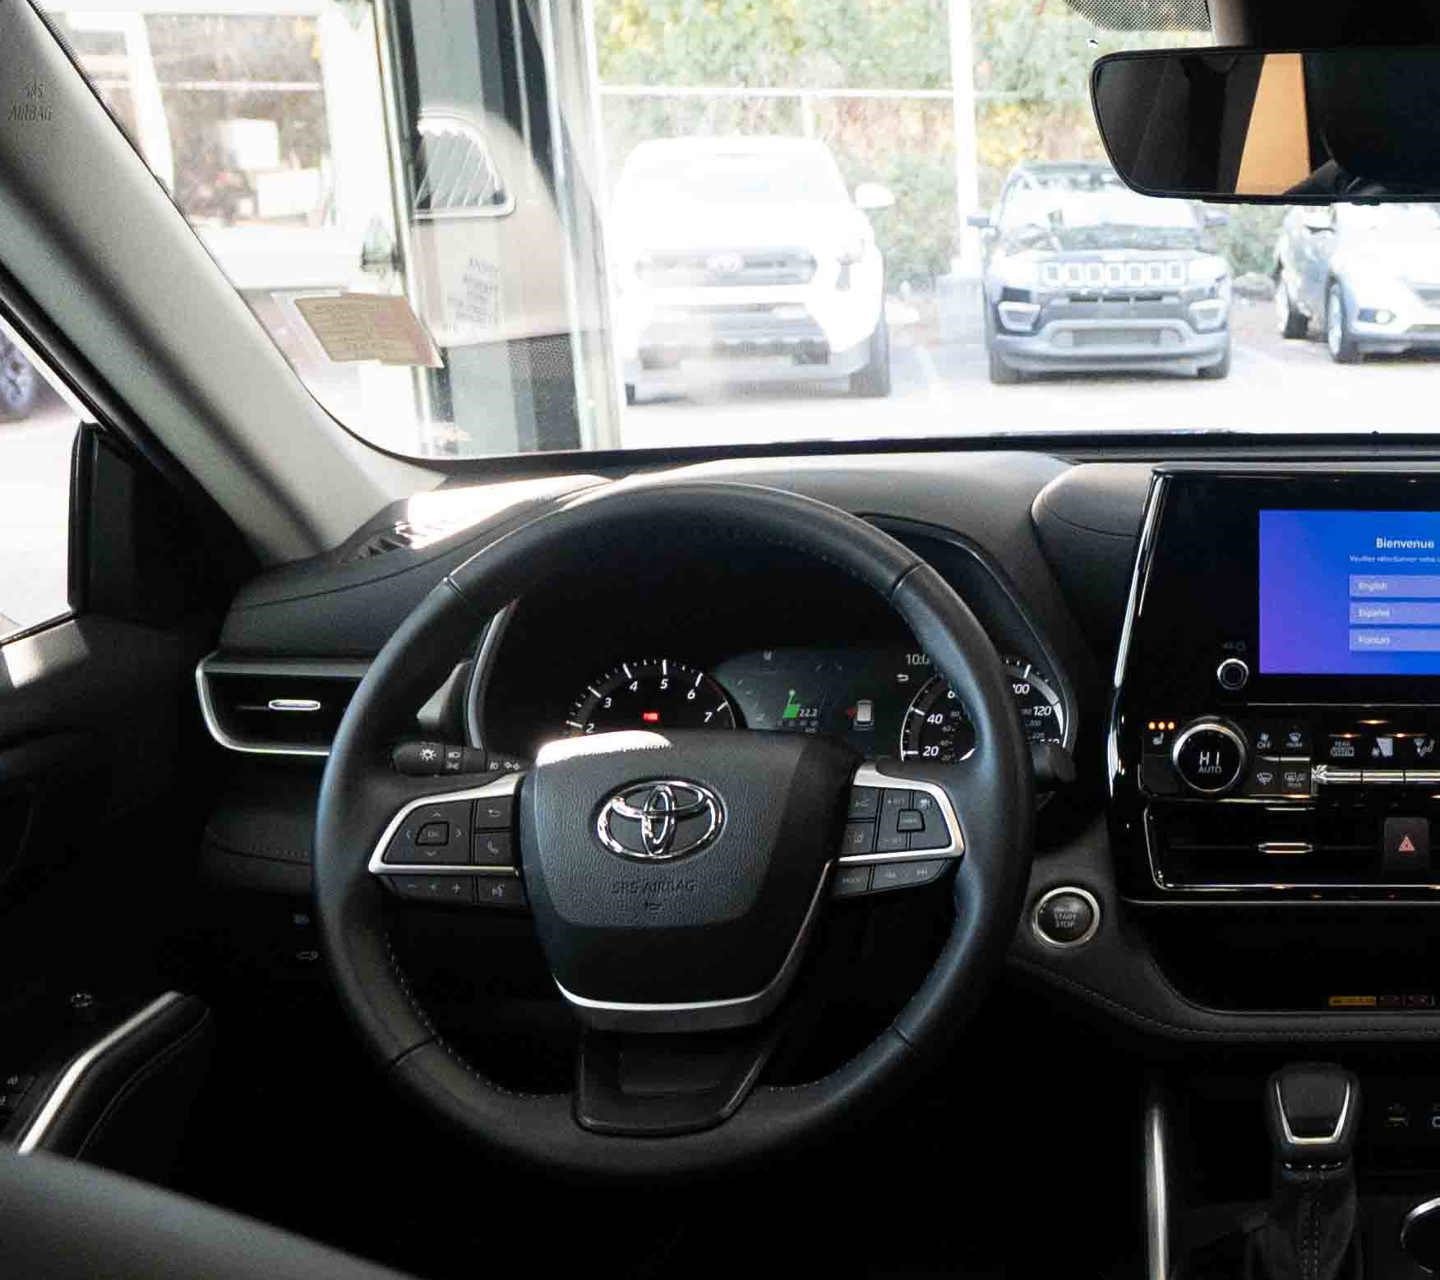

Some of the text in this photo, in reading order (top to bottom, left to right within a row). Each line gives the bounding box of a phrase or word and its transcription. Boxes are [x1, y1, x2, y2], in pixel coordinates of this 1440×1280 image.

[1375, 537, 1435, 549] Bienvenue
[1358, 581, 1388, 593] English
[629, 680, 639, 692] 4
[660, 678, 668, 690] 5
[687, 690, 696, 701] 6
[603, 697, 613, 709] 3
[703, 711, 713, 724] 7
[1033, 706, 1053, 717] 120
[926, 713, 944, 725] 40
[586, 723, 595, 734] 2
[922, 745, 940, 757] 20
[1199, 751, 1220, 767] HI
[1198, 766, 1223, 774] AUTO
